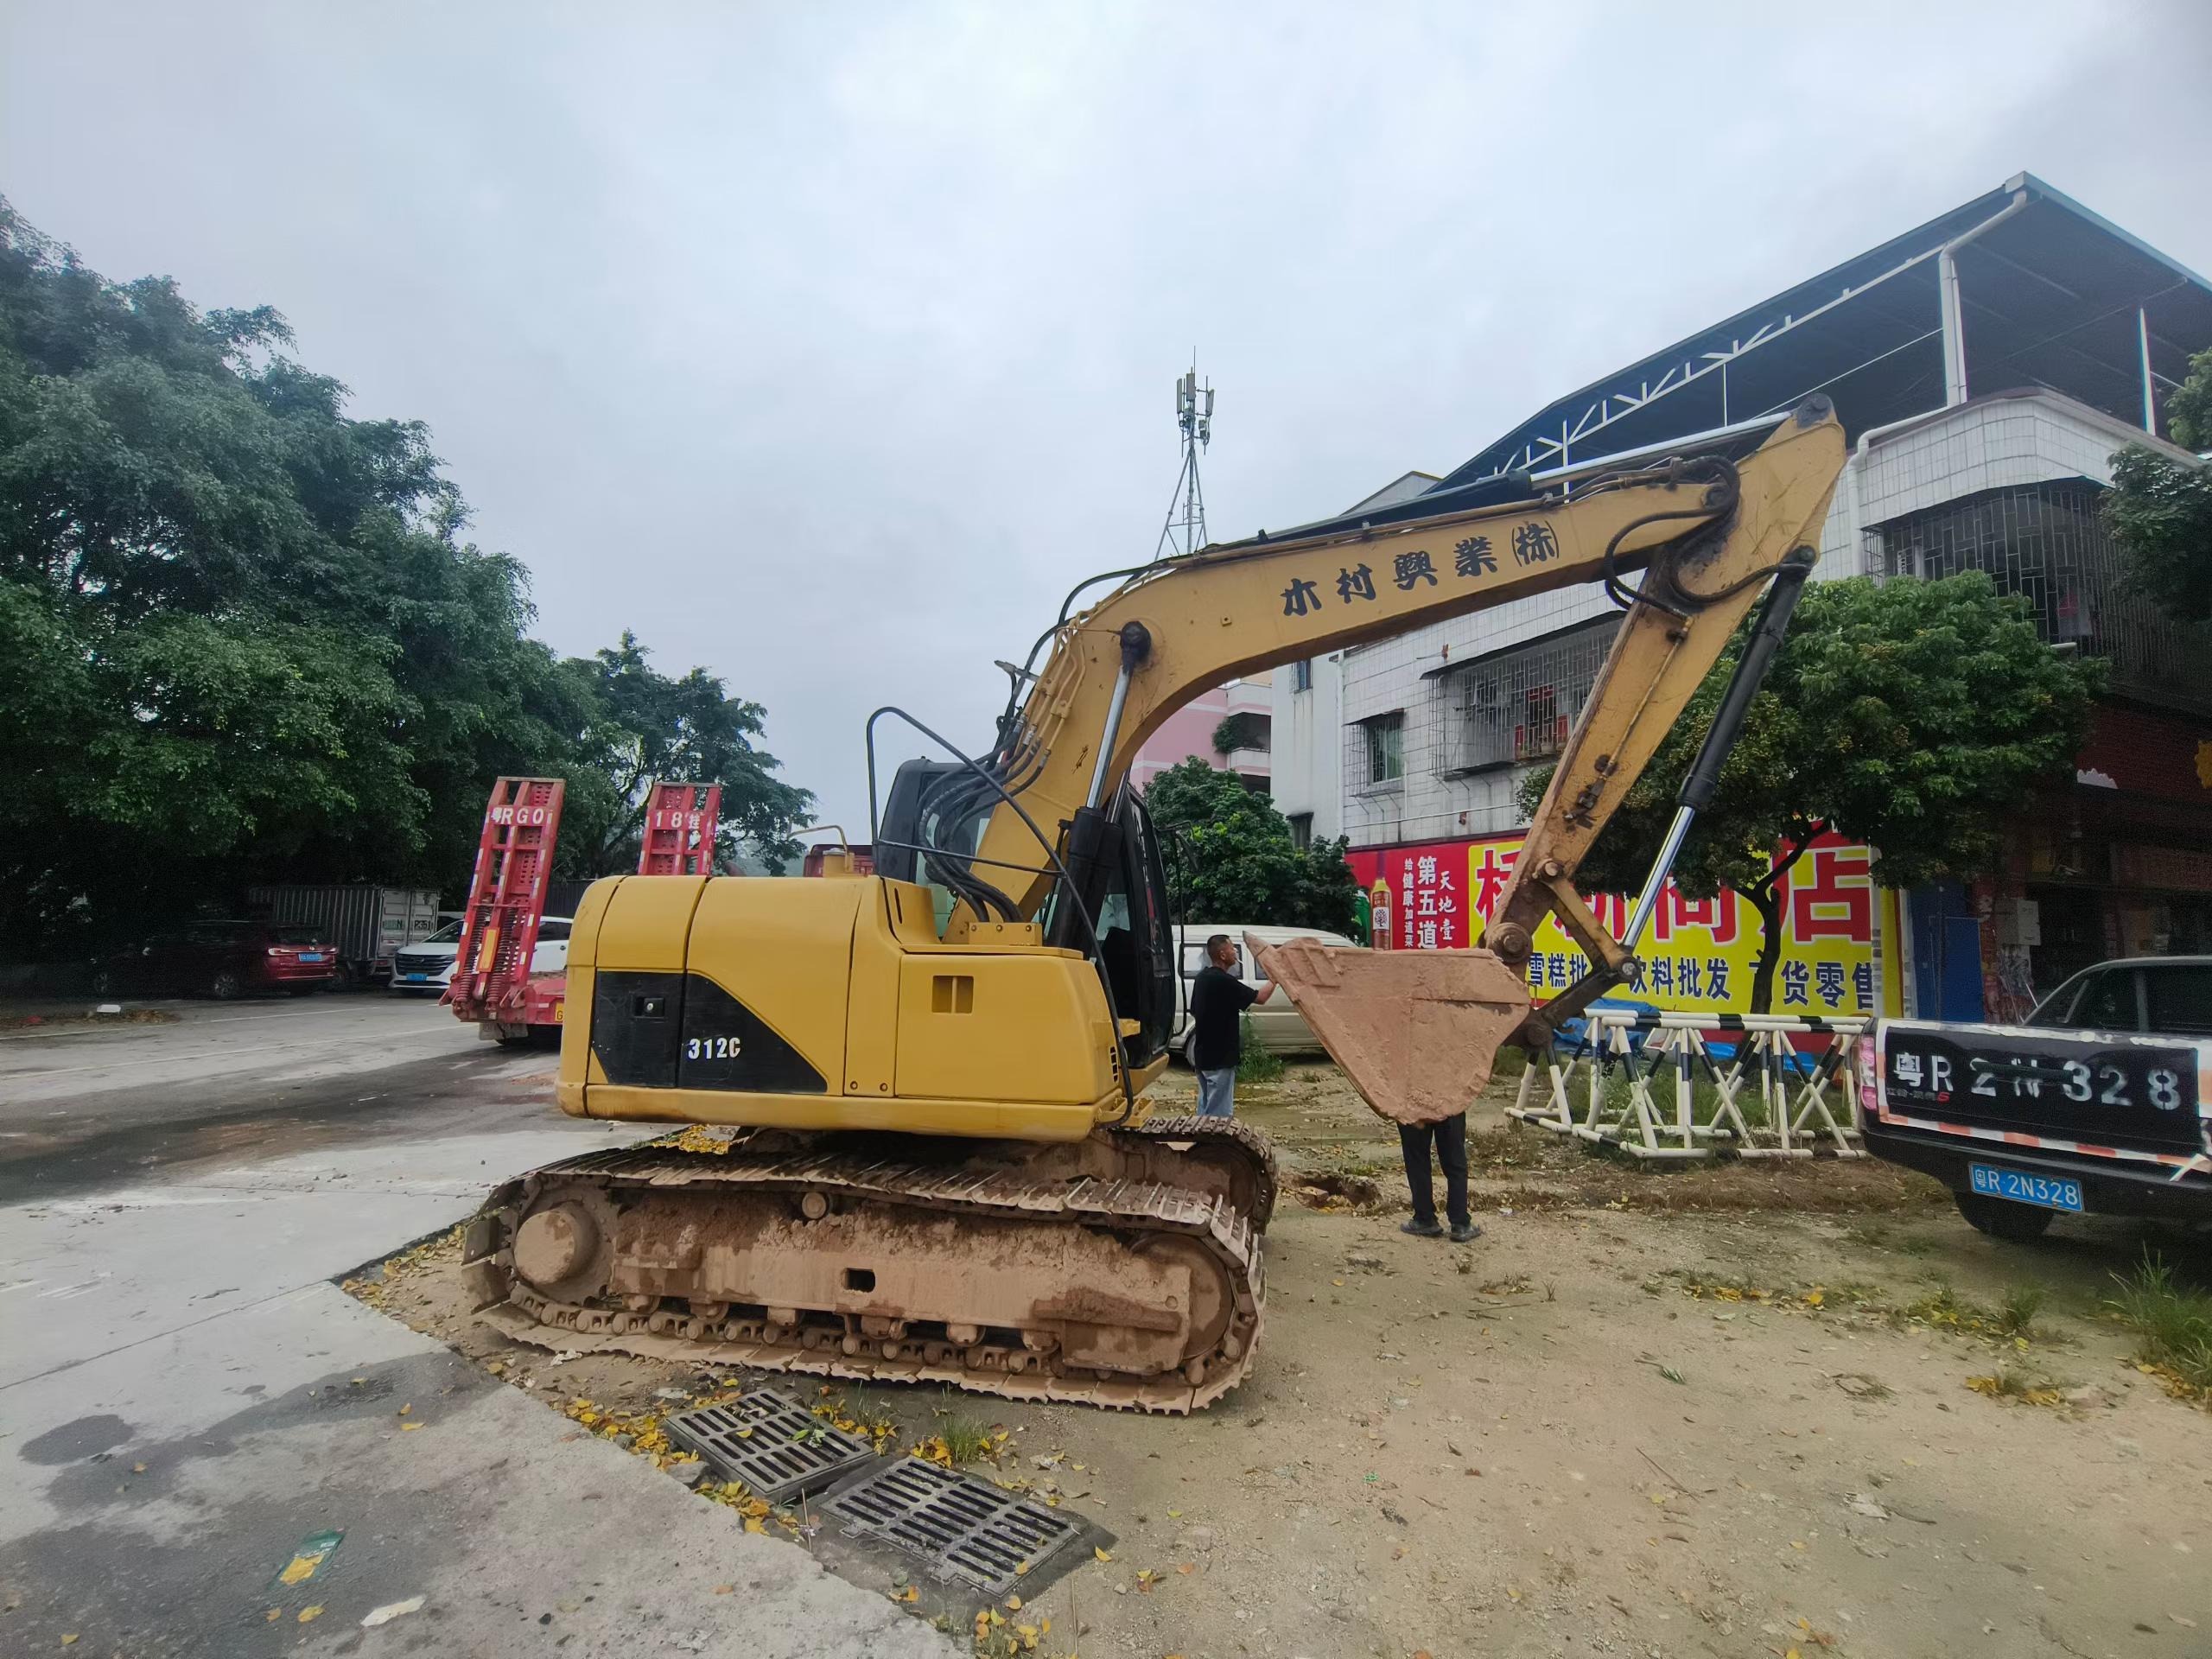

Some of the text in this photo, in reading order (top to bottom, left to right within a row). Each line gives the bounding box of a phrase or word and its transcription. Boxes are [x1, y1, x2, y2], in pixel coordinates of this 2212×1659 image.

[1417, 855, 1438, 949] 第五道
[1476, 820, 1872, 943] 商店
[1749, 960, 1873, 1009] 货零售
[688, 1037, 741, 1059] 312C
